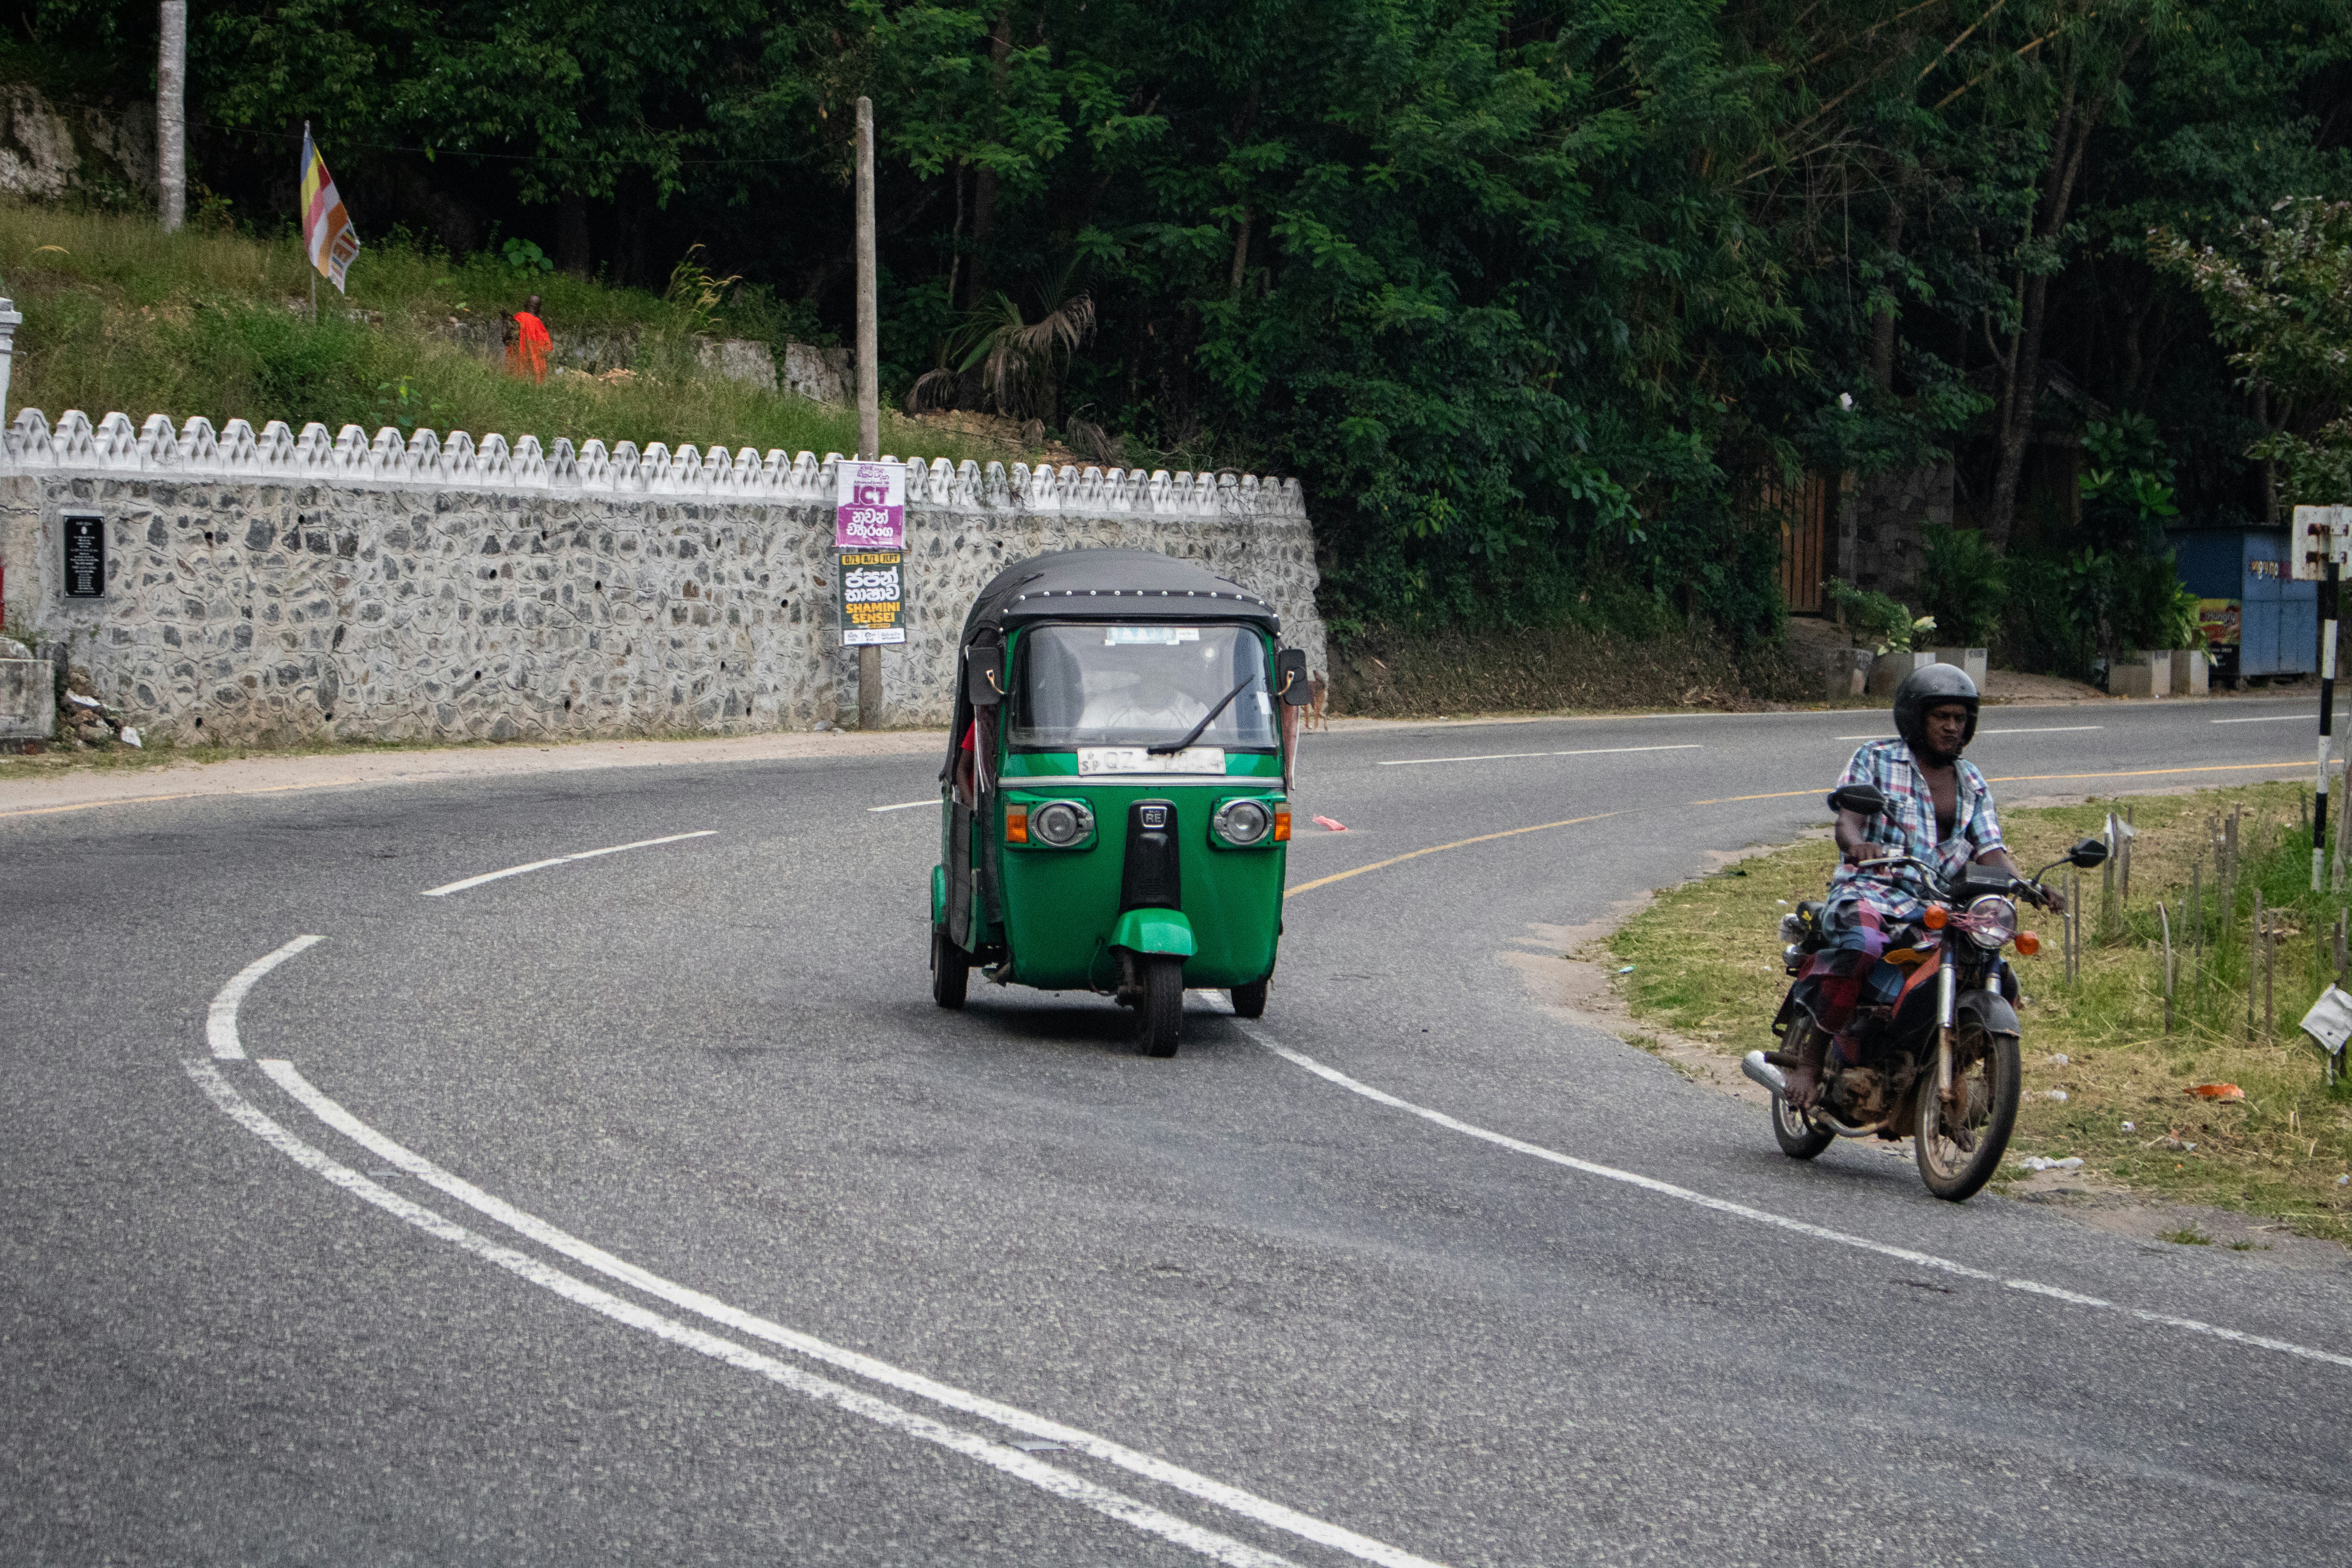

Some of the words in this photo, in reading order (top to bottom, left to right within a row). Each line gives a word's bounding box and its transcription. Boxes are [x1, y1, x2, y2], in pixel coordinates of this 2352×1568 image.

[853, 485, 890, 505] ICT
[846, 602, 900, 614] SHAMINI
[852, 612, 895, 624] SENSEI
[1082, 760, 1100, 771] SP
[1104, 751, 1137, 770] QZ
[1146, 813, 1162, 823] RE
